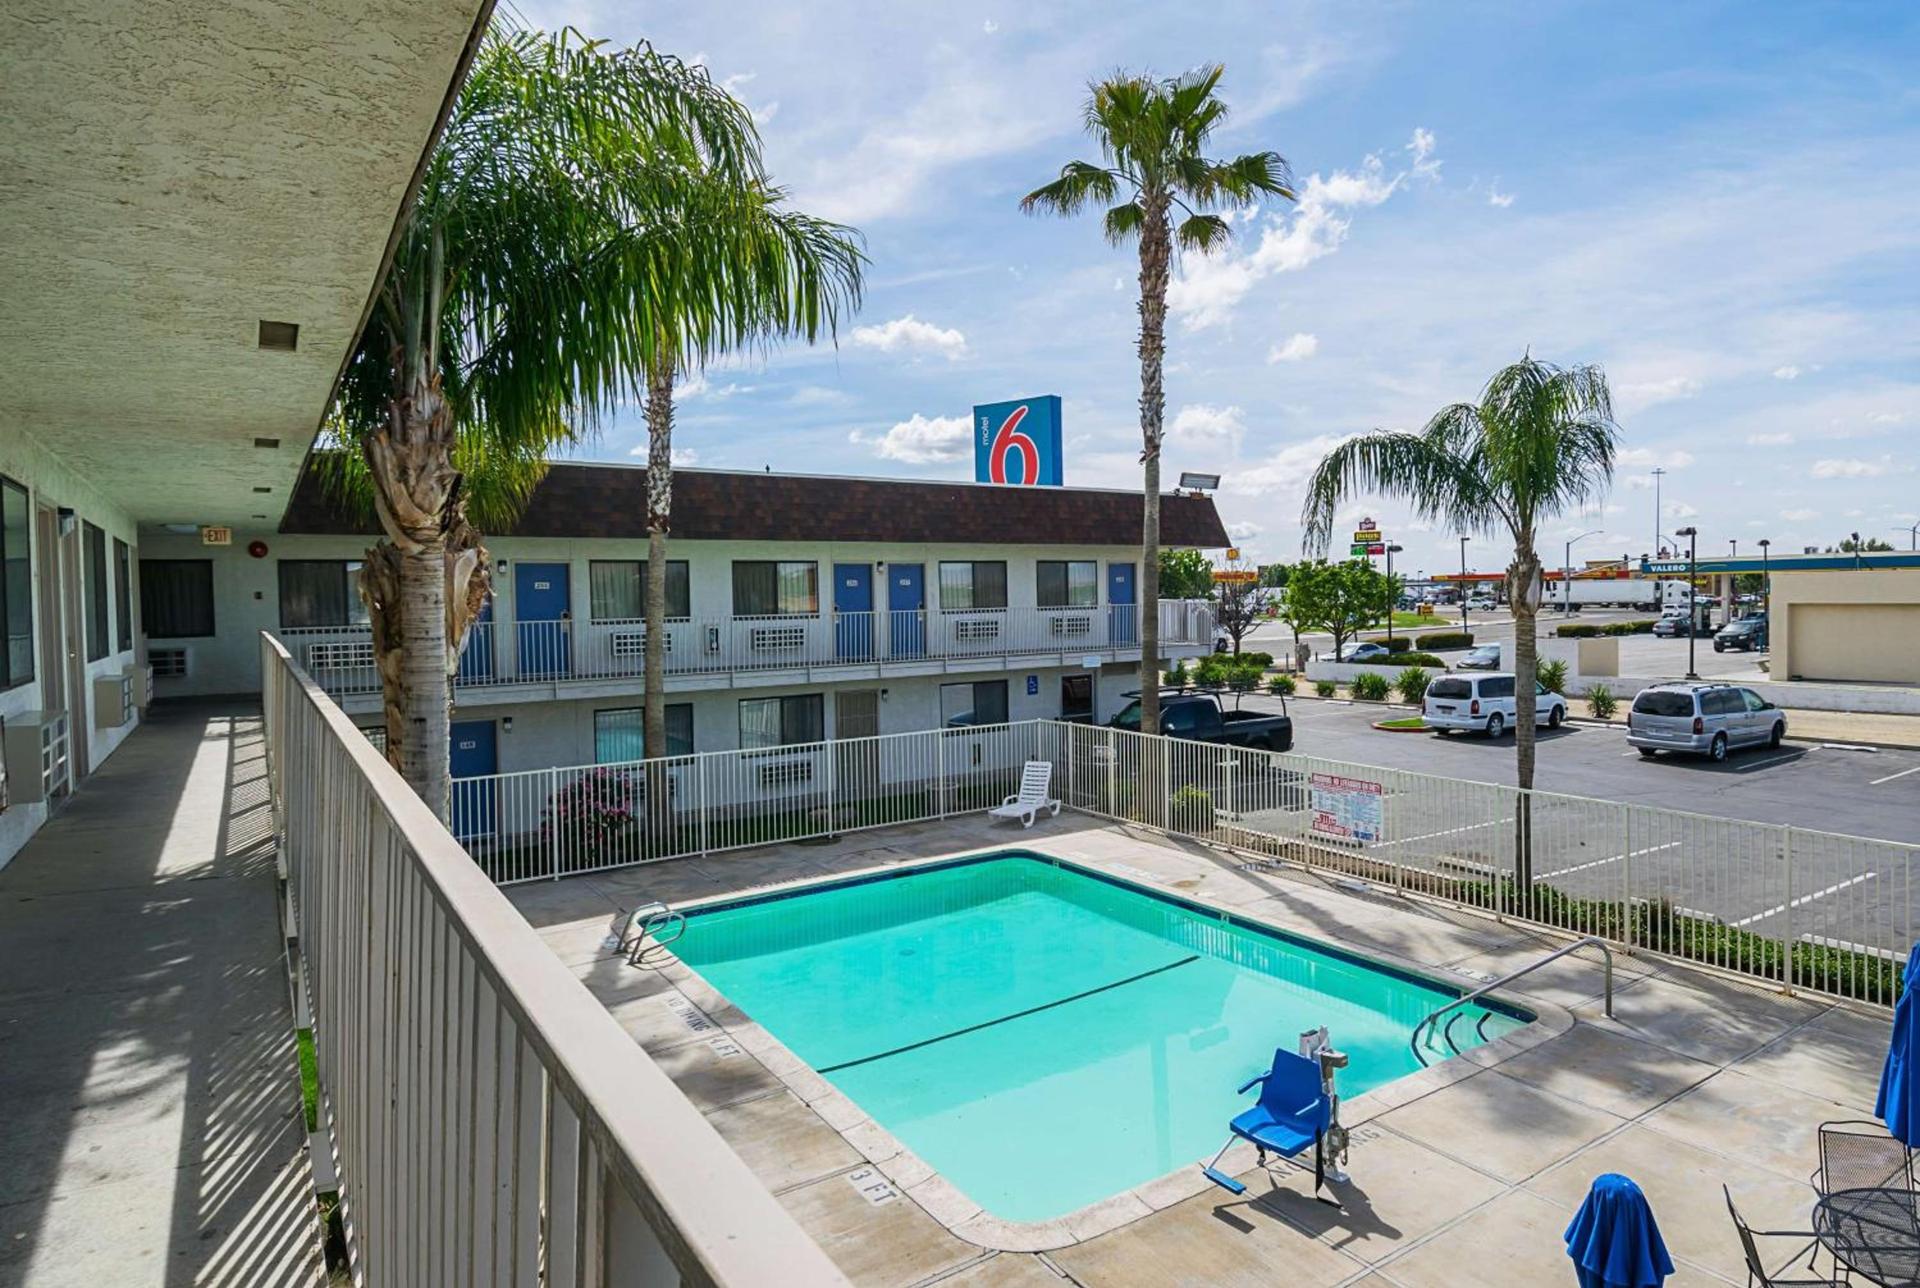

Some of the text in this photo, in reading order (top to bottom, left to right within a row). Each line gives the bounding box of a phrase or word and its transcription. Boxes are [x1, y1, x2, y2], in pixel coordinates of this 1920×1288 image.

[981, 404, 1040, 487] motel 6
[207, 530, 227, 543] EXIT
[1650, 564, 1687, 572] VALERO
[849, 1169, 897, 1202] 3 FT
